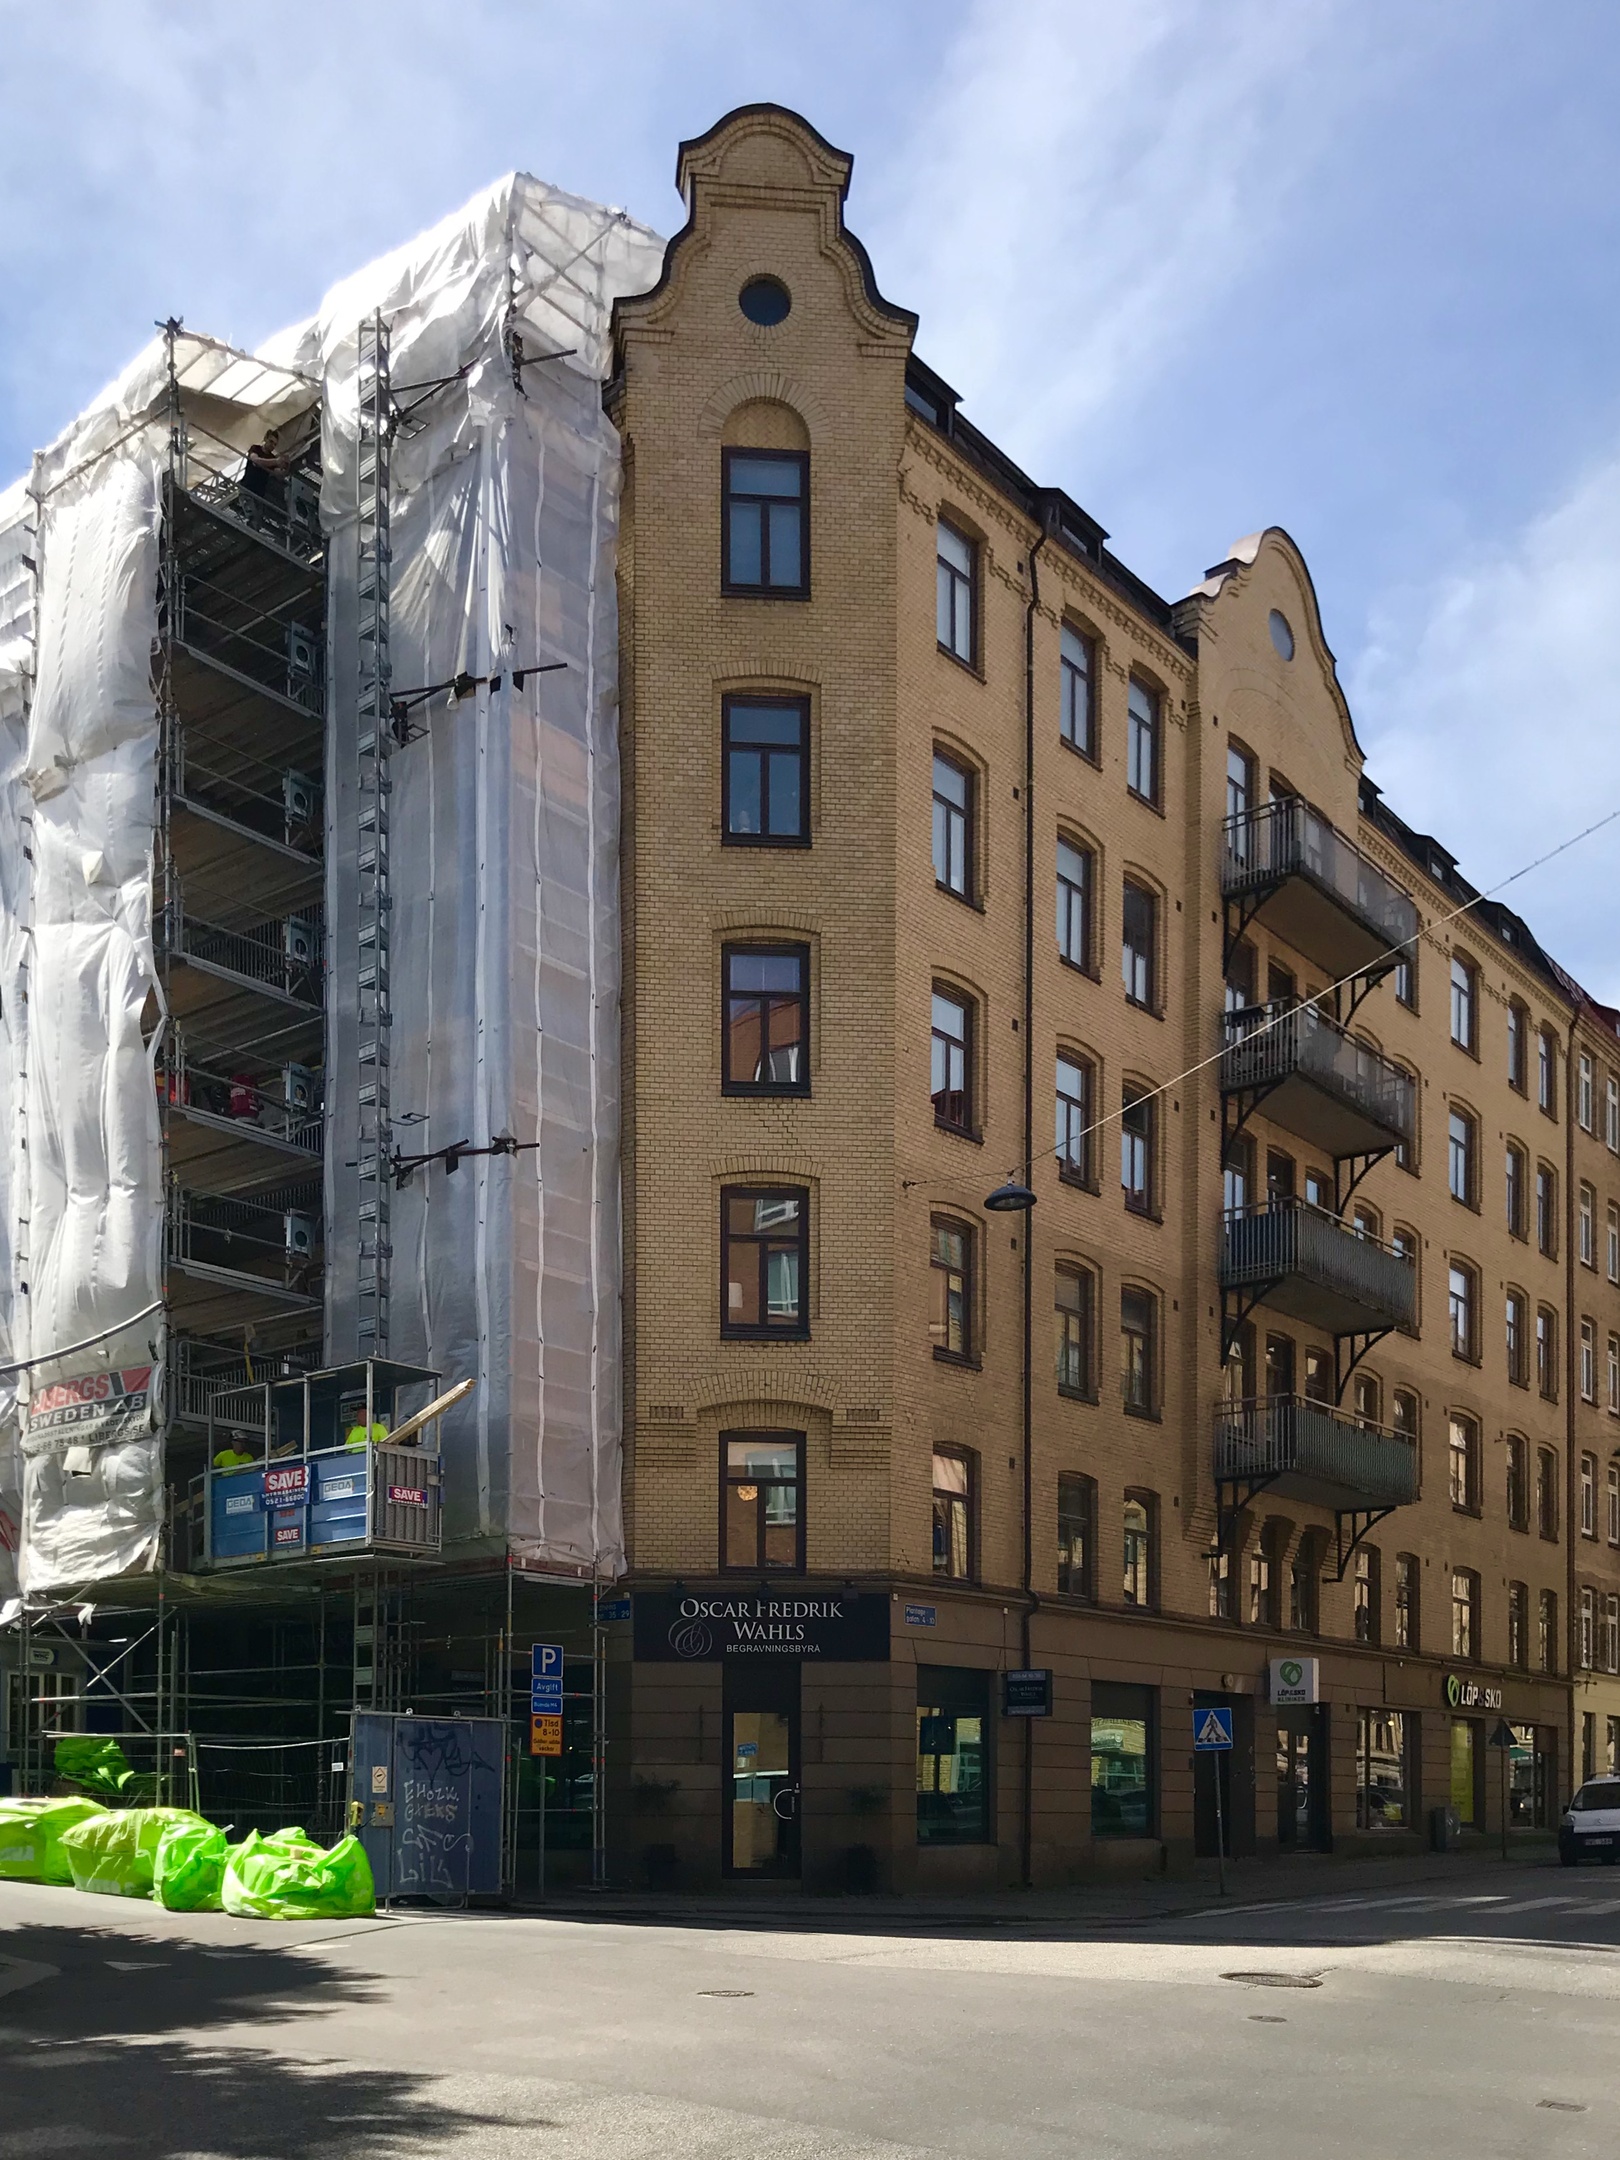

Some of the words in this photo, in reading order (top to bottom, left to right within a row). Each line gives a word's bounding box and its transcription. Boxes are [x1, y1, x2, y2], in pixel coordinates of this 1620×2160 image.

[31, 1373, 110, 1416] LIBERGS
[29, 1403, 106, 1432] SWEDEN
[112, 1395, 144, 1413] AB
[268, 1470, 303, 1491] SAVE
[393, 1488, 422, 1502] SAVE
[276, 1528, 299, 1542] SAVE
[620, 1609, 630, 1618] 29
[680, 1598, 751, 1618] OSCAR
[755, 1599, 843, 1618] FREDRIK
[733, 1621, 805, 1640] WAHLS
[726, 1643, 821, 1653] BEGRAVNINGSBYRÅ
[536, 1682, 559, 1693] Avgift
[543, 1719, 559, 1727] Tisd
